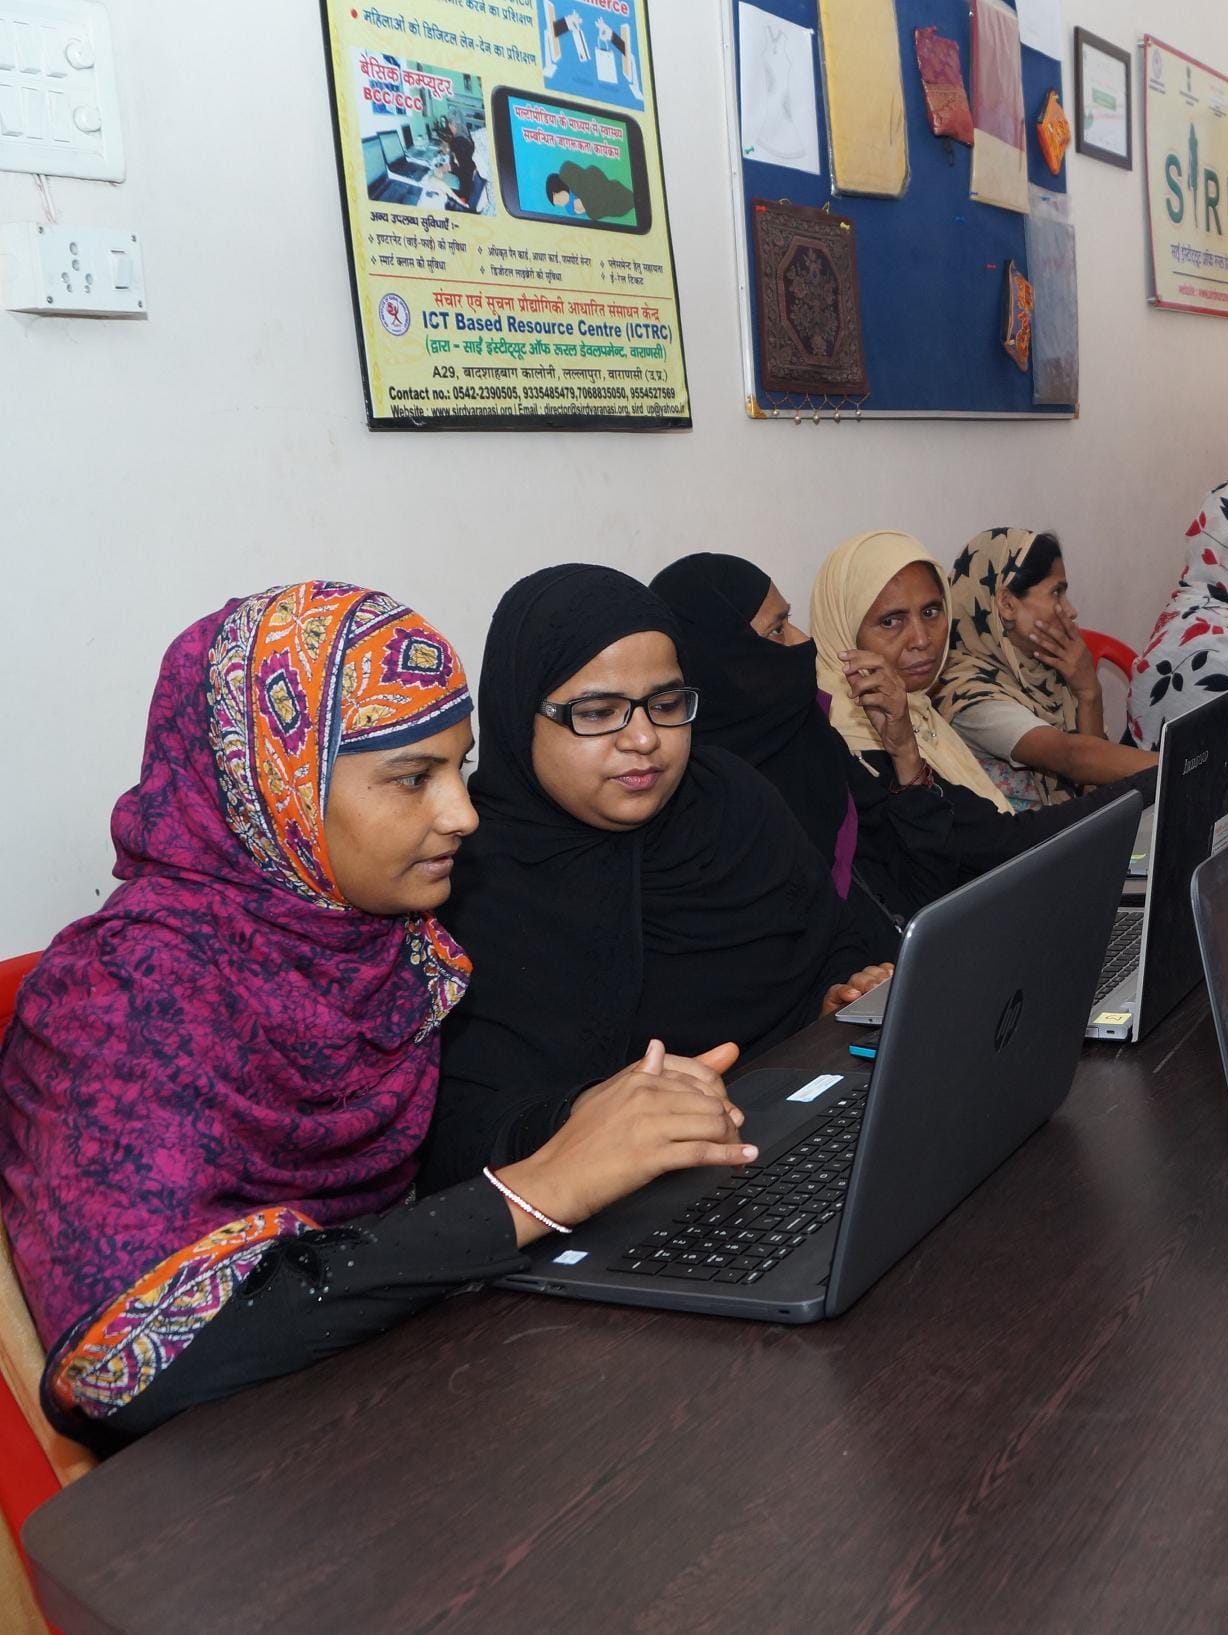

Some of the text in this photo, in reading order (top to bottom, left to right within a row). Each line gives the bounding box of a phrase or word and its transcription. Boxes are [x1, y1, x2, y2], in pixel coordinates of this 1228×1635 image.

[488, 5, 501, 18] का
[502, 6, 534, 27] प्रशिक्षण
[408, 19, 422, 35] को
[422, 21, 457, 46] डिजिटल
[493, 43, 507, 58] का
[508, 45, 537, 66] प्रशिक्षण
[359, 53, 399, 83] बेसिक
[432, 287, 661, 322] संचार एवं सूचना प्रौद्योगिकी आधारित संसाधन केन्द्र
[422, 310, 449, 330] ICT
[454, 312, 502, 333] Based
[506, 315, 574, 336] Resource
[577, 319, 622, 338] Centre
[626, 322, 672, 345] (ICTRC)
[630, 344, 667, 362] वाराणसी)
[433, 366, 460, 380] A29,
[463, 366, 518, 381] बादशाहबाग
[607, 367, 642, 381] वाराणसी
[389, 386, 430, 400] Contact
[453, 386, 521, 402] 0542-2390505,
[631, 387, 676, 400] 9554527569
[390, 404, 425, 417] Website
